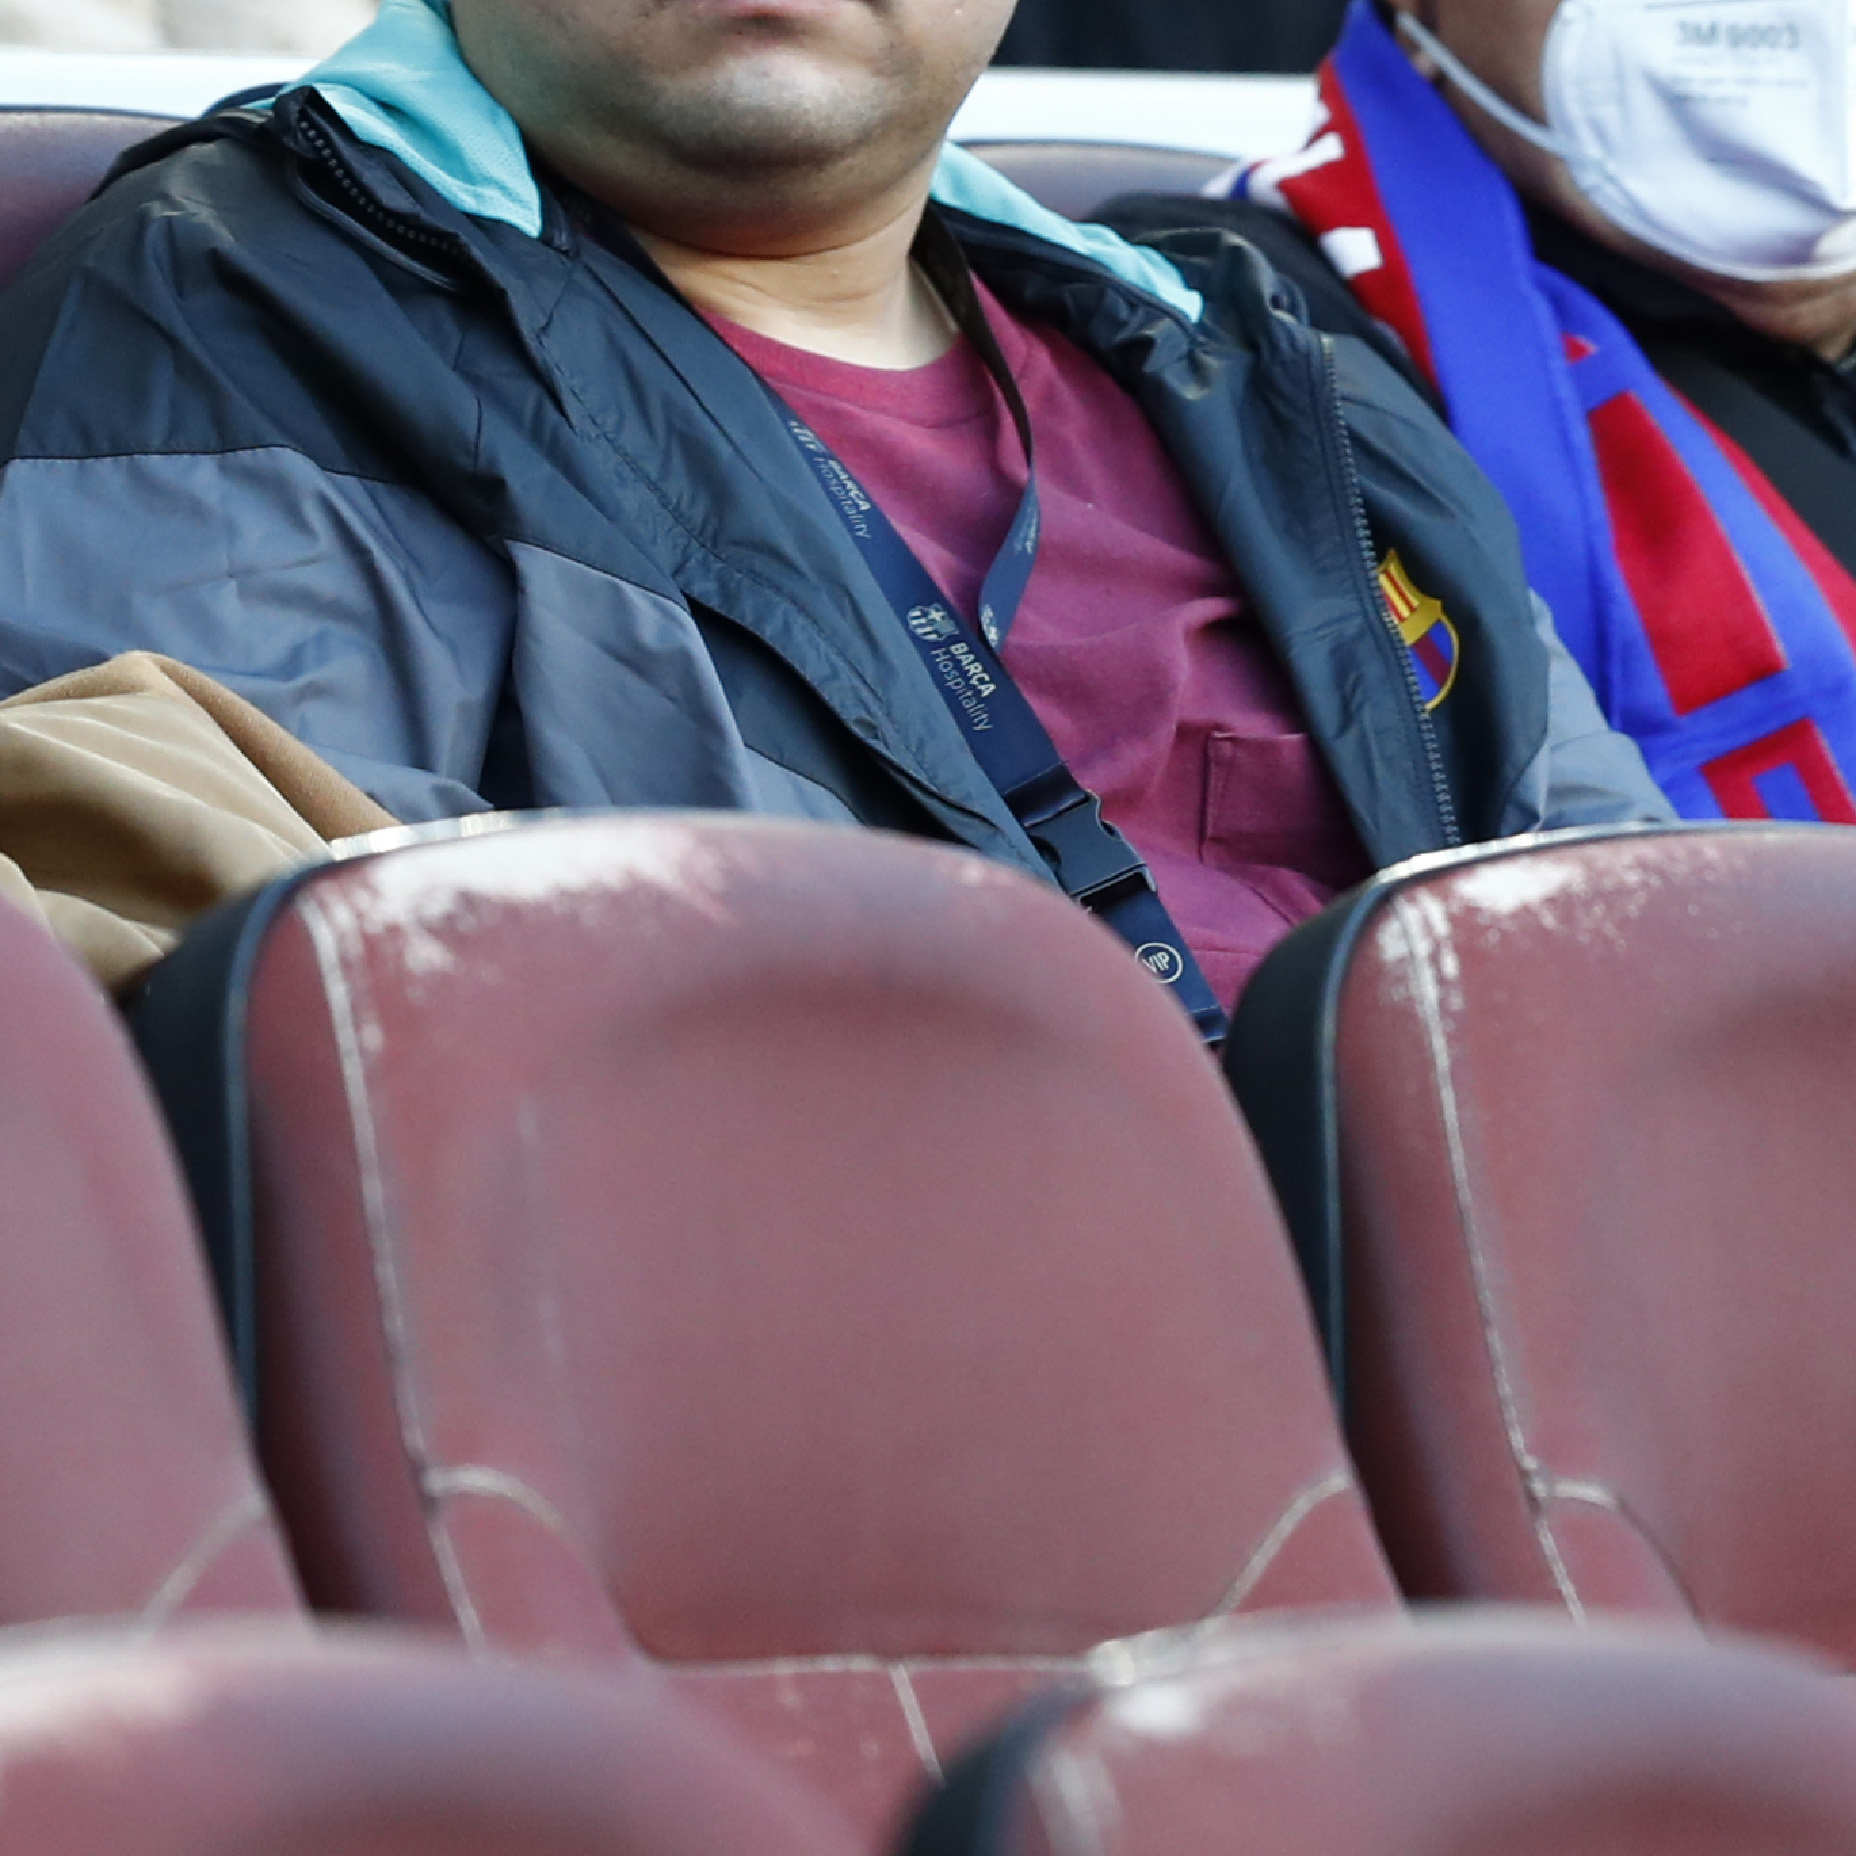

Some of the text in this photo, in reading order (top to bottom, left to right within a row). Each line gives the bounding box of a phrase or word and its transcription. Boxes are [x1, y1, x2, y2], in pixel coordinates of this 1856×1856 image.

[930, 646, 994, 732] Hospitality
[948, 642, 998, 698] BARÇA
[1142, 951, 1170, 975] VIP
